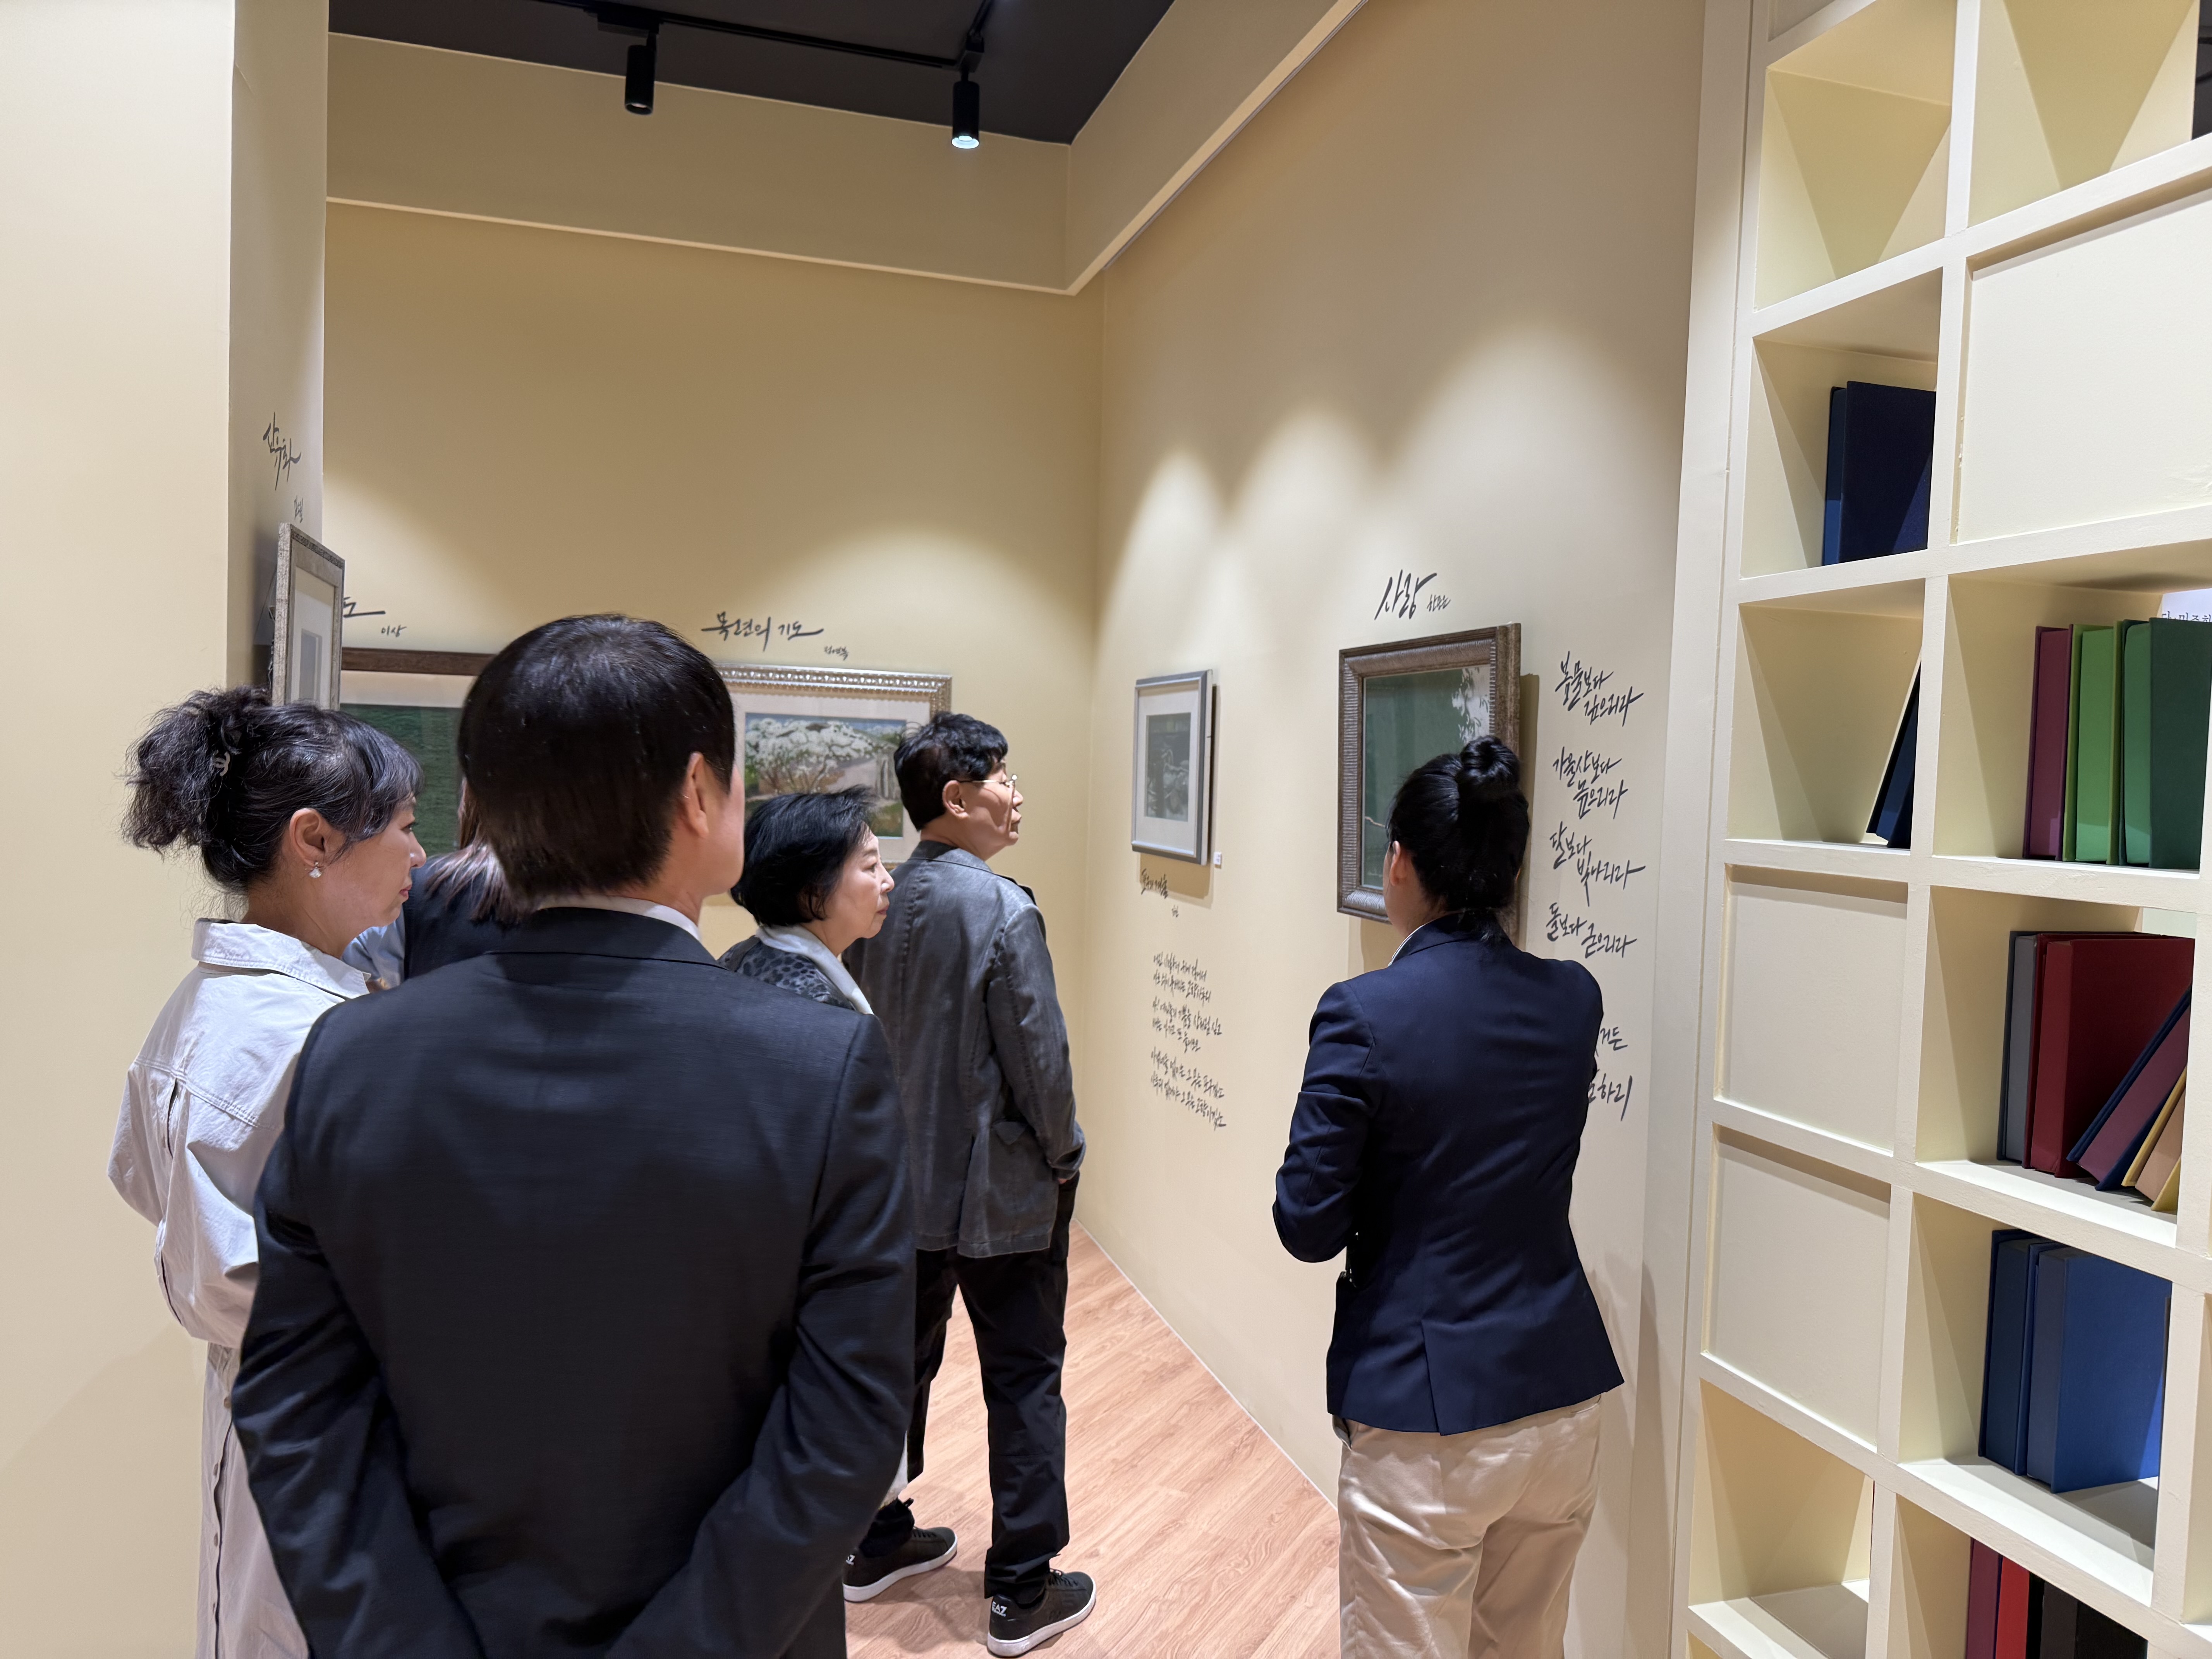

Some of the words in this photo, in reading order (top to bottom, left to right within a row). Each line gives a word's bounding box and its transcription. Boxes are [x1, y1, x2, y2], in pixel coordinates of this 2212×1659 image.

[1374, 569, 1437, 620] 사랑
[381, 625, 407, 637] 이상
[701, 611, 771, 652] 목련의
[778, 621, 824, 641] 기도
[1554, 650, 1614, 712] 봄물보다
[1583, 686, 1644, 727] 깊으리라
[1552, 746, 1622, 788] 가을산보다
[1573, 779, 1628, 820] 높으리라
[1549, 821, 1592, 870] 달보다
[1577, 850, 1646, 907] 빛나리라
[1546, 902, 1587, 942] 돌보다
[1581, 922, 1638, 959] 굳으리라
[991, 1601, 1007, 1616] EA7
